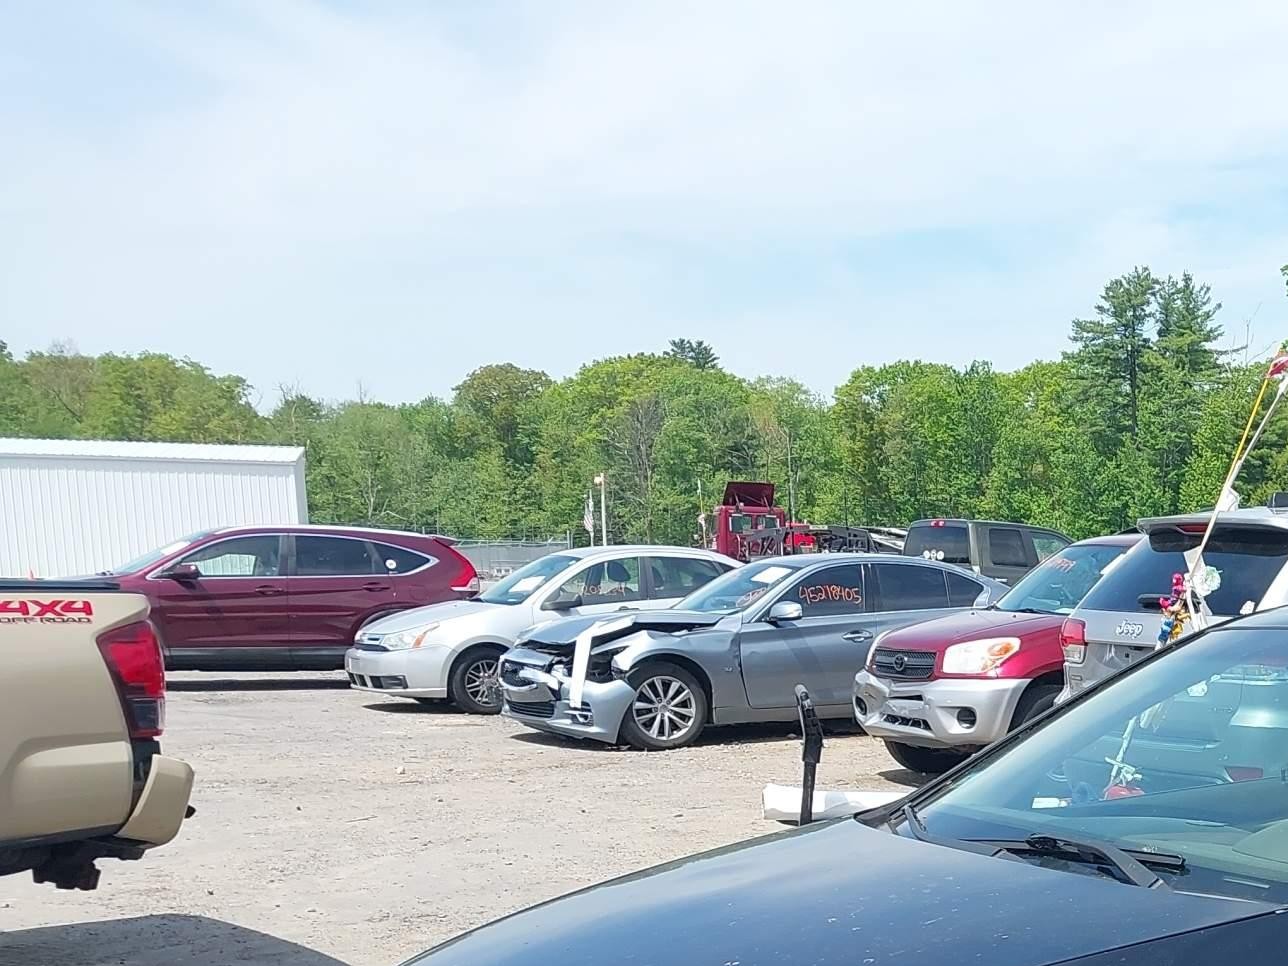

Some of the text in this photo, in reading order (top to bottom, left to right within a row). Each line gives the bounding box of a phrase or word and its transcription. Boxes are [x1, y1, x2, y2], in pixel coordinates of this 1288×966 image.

[799, 584, 862, 604] 45218405
[40, 616, 92, 624] ROAD
[1116, 618, 1143, 639] Jeep
